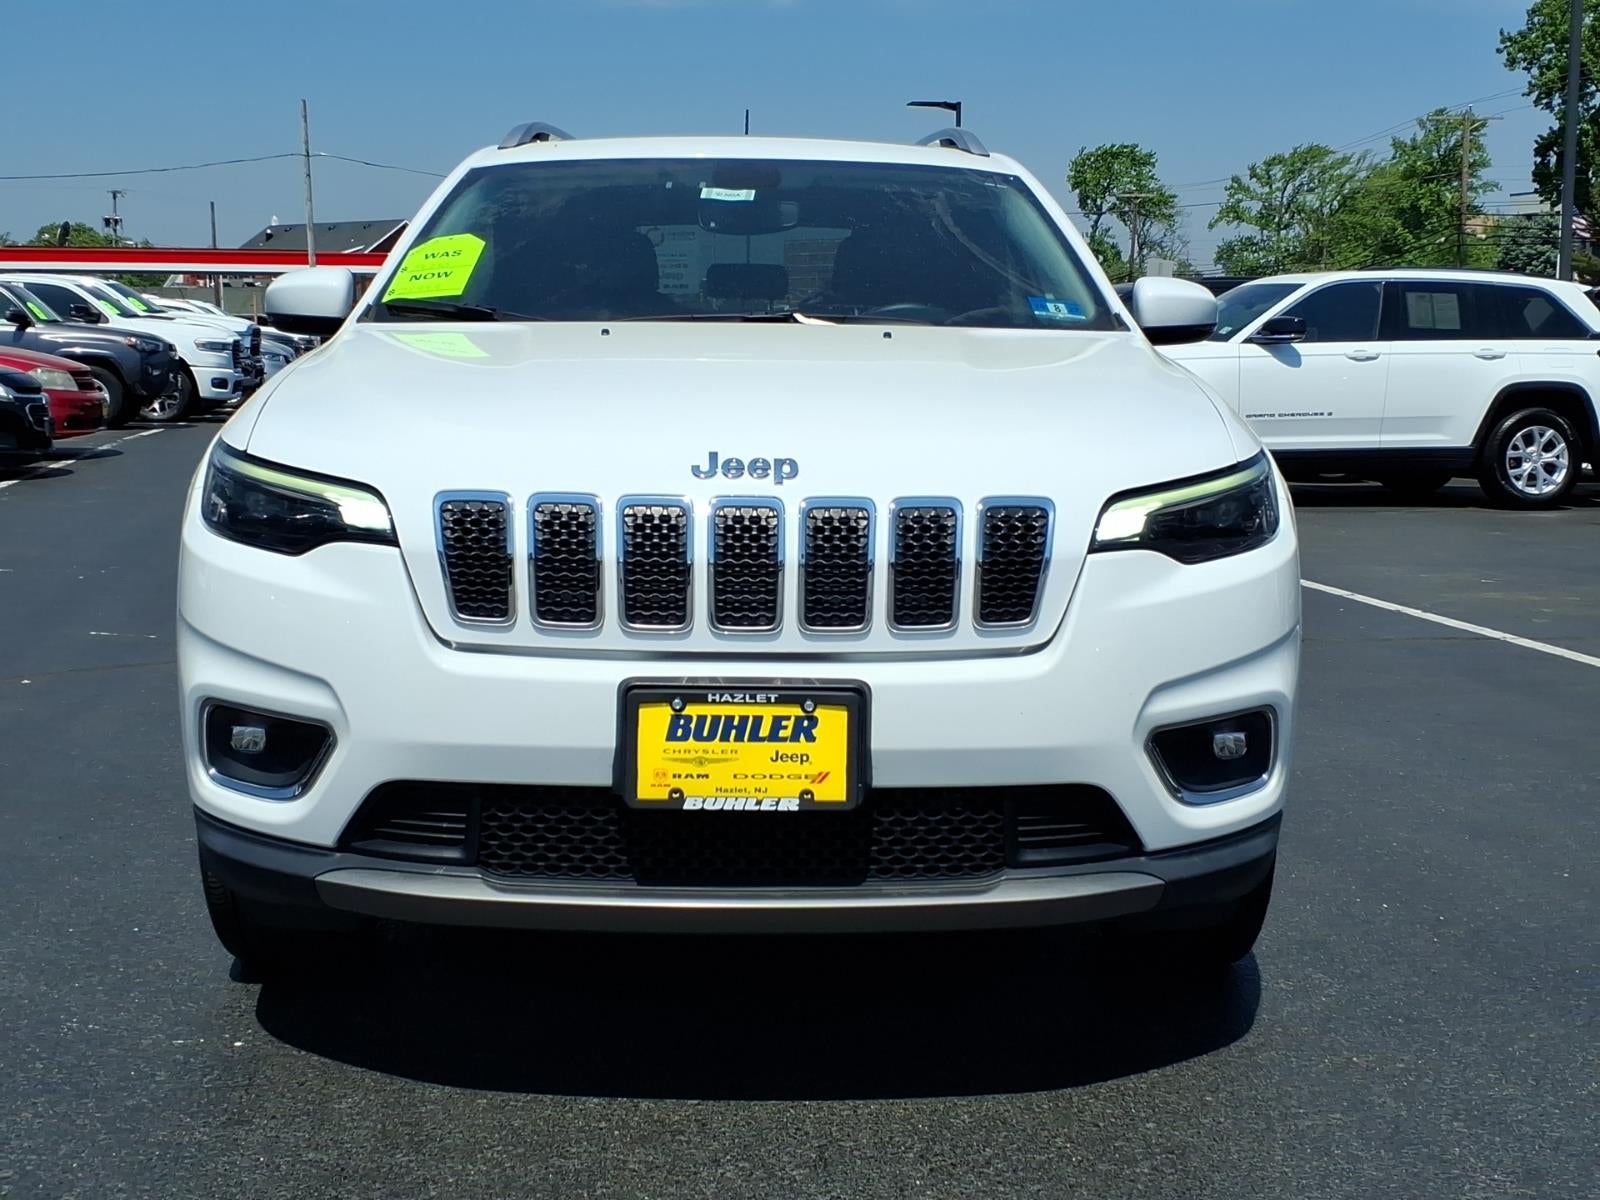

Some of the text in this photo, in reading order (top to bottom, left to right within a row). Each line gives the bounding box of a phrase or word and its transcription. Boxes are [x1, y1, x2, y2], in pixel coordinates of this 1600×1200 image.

[424, 249, 462, 259] WAS
[408, 271, 453, 282] NOW
[1054, 304, 1061, 312] 8
[690, 451, 799, 486] Jeep
[707, 693, 779, 703] HAZLET
[666, 715, 818, 742] BUHLER
[770, 750, 810, 766] Jeep
[682, 797, 800, 811] BUHLER
